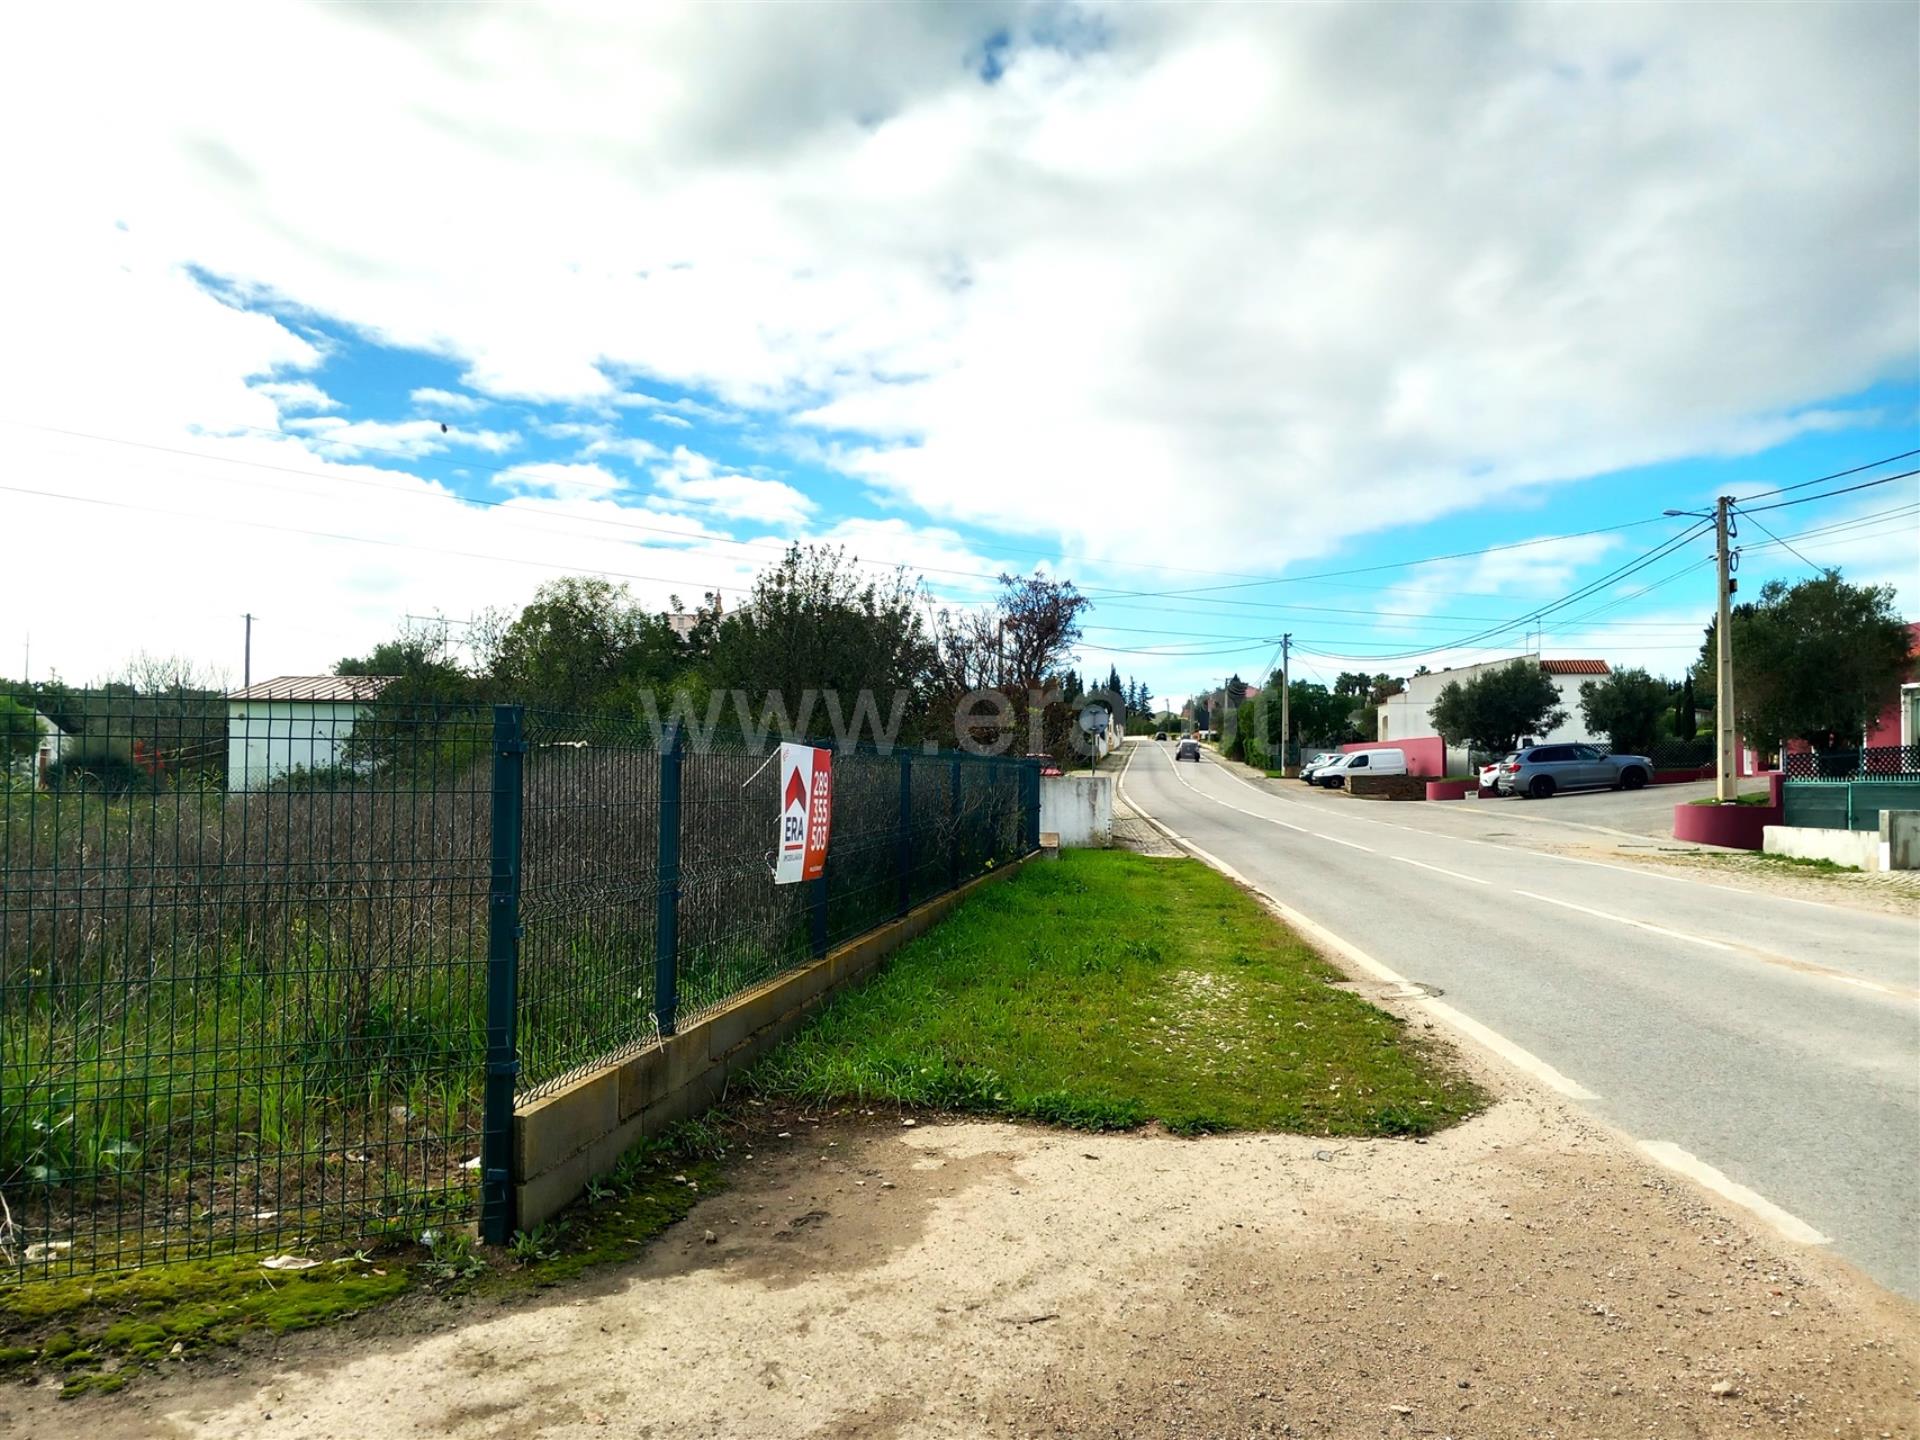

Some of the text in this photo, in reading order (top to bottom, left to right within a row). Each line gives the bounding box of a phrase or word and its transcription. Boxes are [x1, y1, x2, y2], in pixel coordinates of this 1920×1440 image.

[813, 771, 828, 796] 289
[813, 798, 827, 823] 355
[785, 816, 803, 841] ERA
[811, 826, 826, 851] 503
